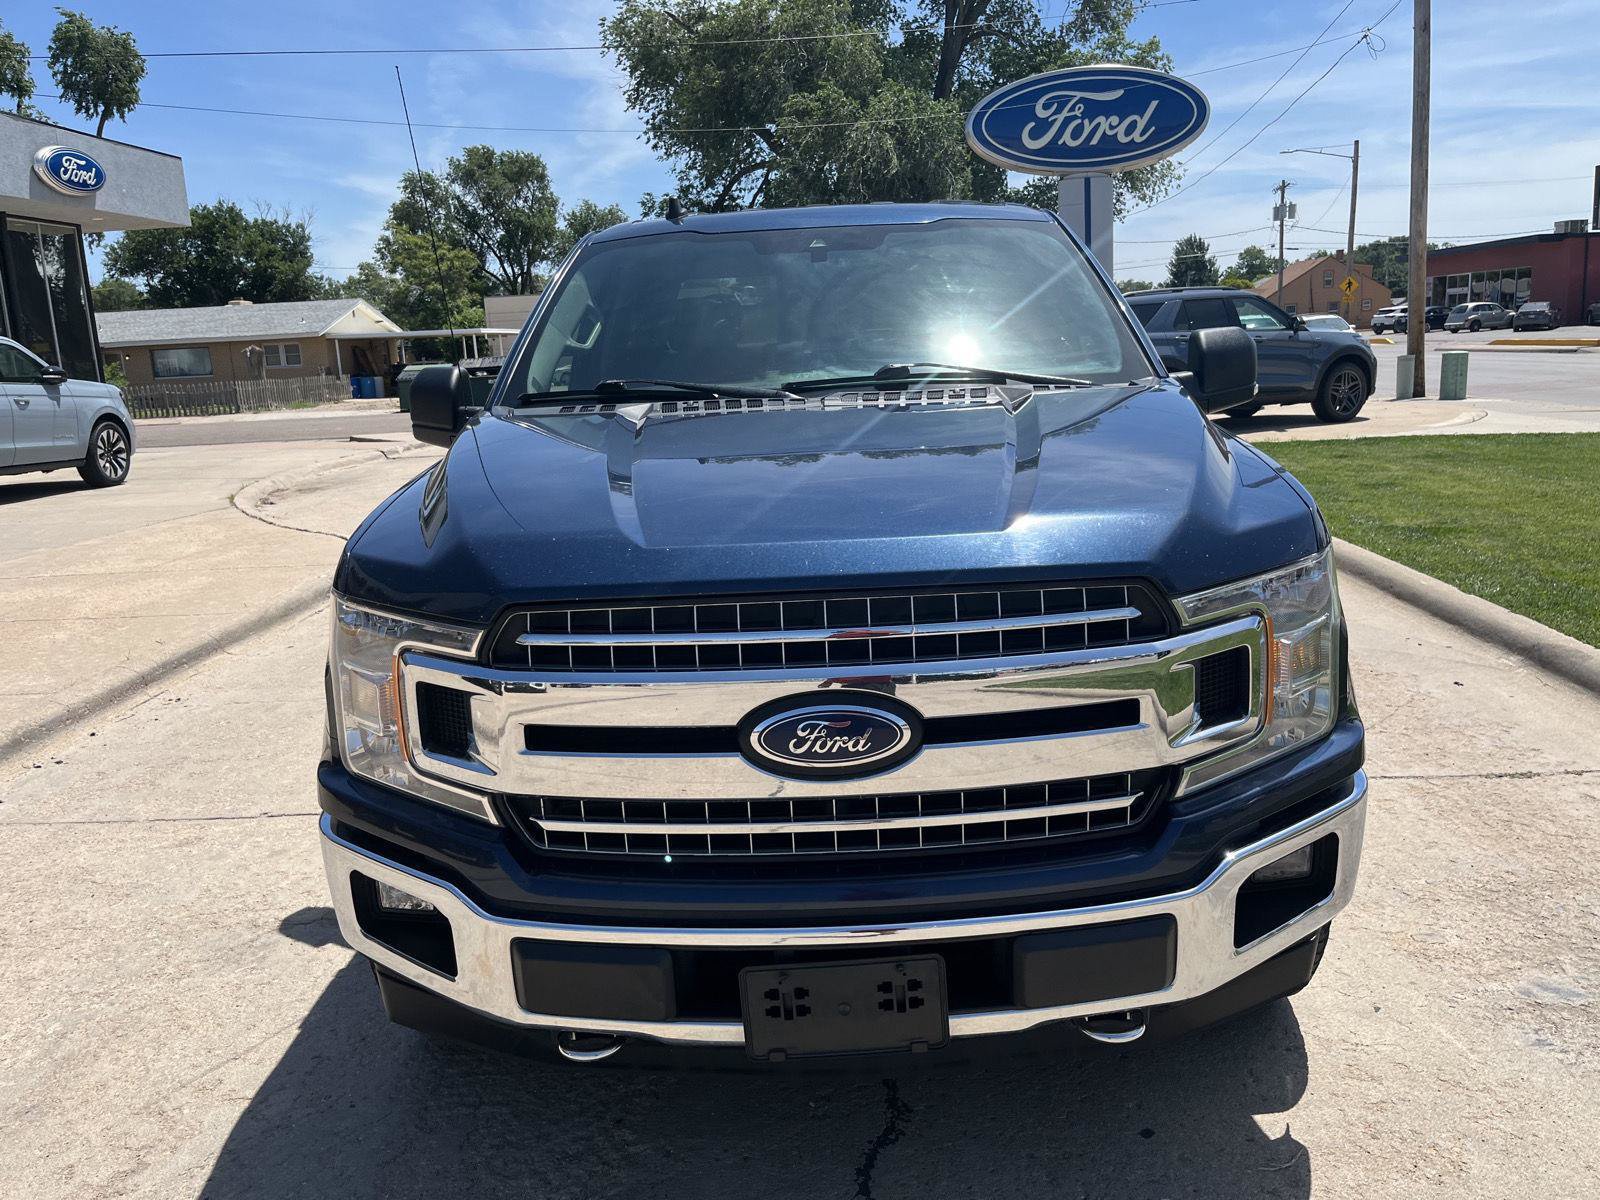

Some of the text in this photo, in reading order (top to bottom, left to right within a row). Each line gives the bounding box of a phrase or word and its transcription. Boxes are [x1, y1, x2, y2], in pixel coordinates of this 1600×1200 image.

[1021, 89, 1160, 150] Ford
[60, 156, 97, 185] Ford
[788, 720, 873, 754] Ford
